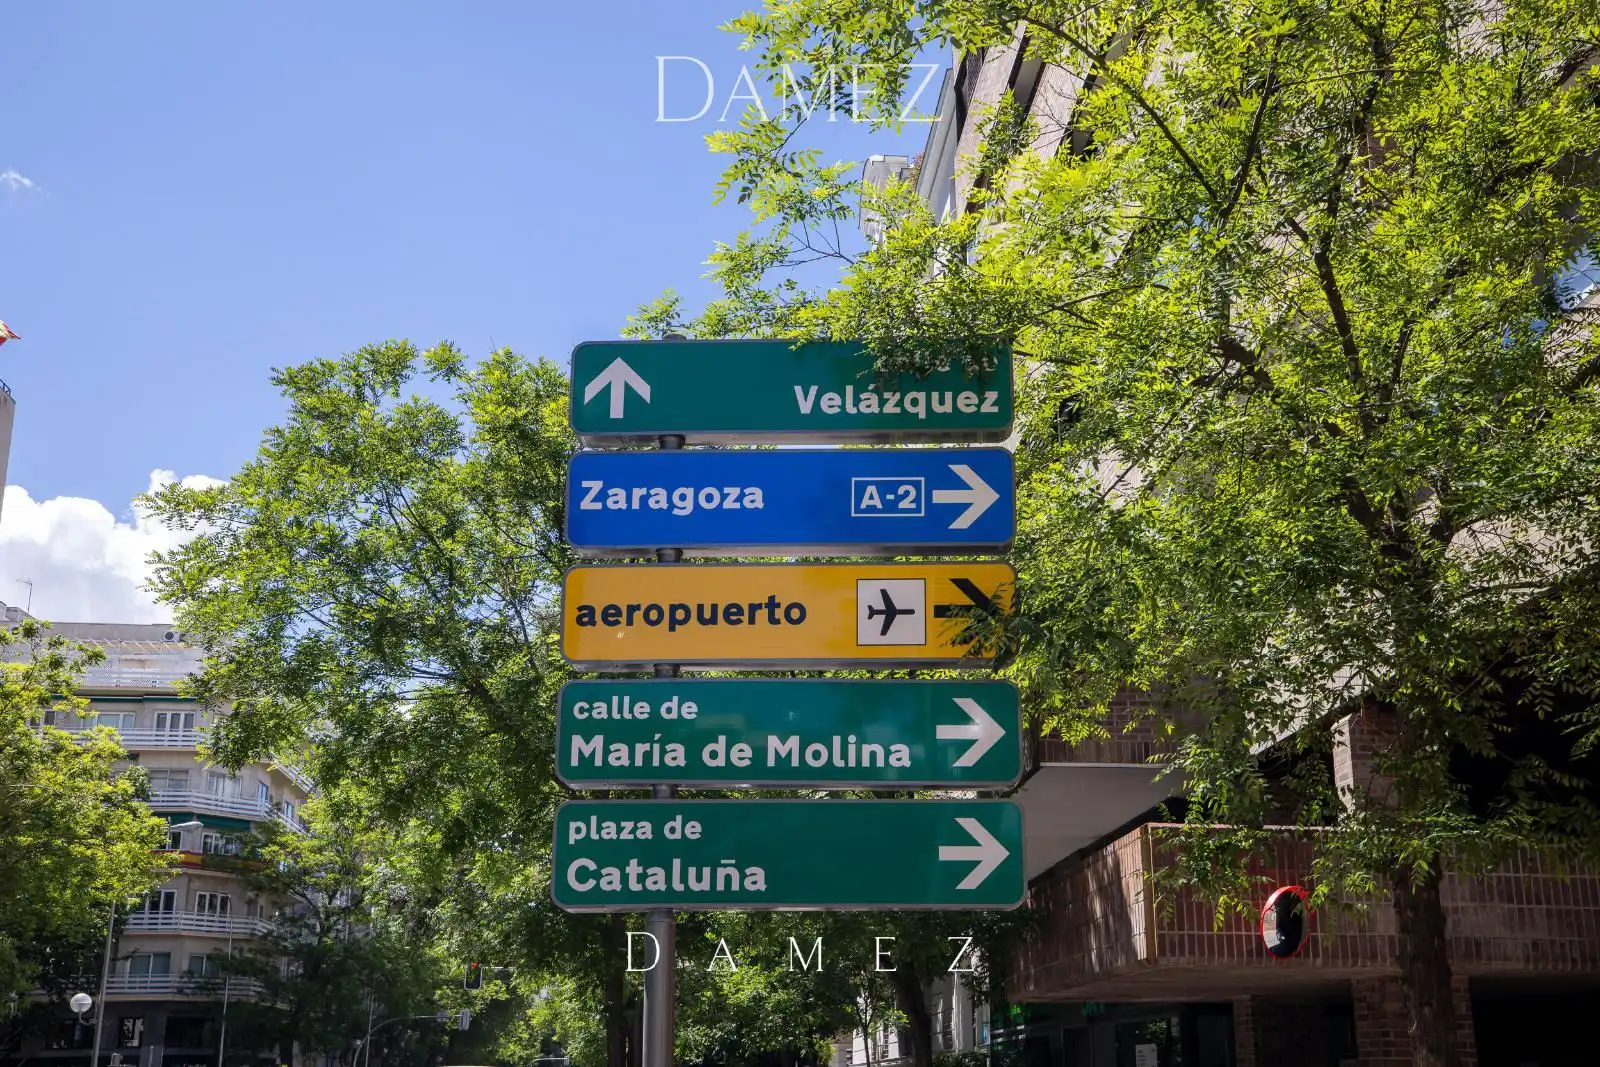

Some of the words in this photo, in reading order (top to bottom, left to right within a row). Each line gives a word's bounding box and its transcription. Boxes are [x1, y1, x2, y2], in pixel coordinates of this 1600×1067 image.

[794, 383, 999, 419] Velázquez
[580, 480, 764, 516] Zaragoza
[860, 484, 917, 509] A-2
[575, 594, 807, 632] aeropuerto
[573, 695, 651, 720] calle
[660, 695, 698, 720] de
[570, 734, 687, 767] María
[702, 735, 753, 767] de
[768, 735, 912, 767] Molina
[568, 815, 653, 845] plaza
[663, 815, 702, 840] de
[567, 857, 767, 892] Cataluña
